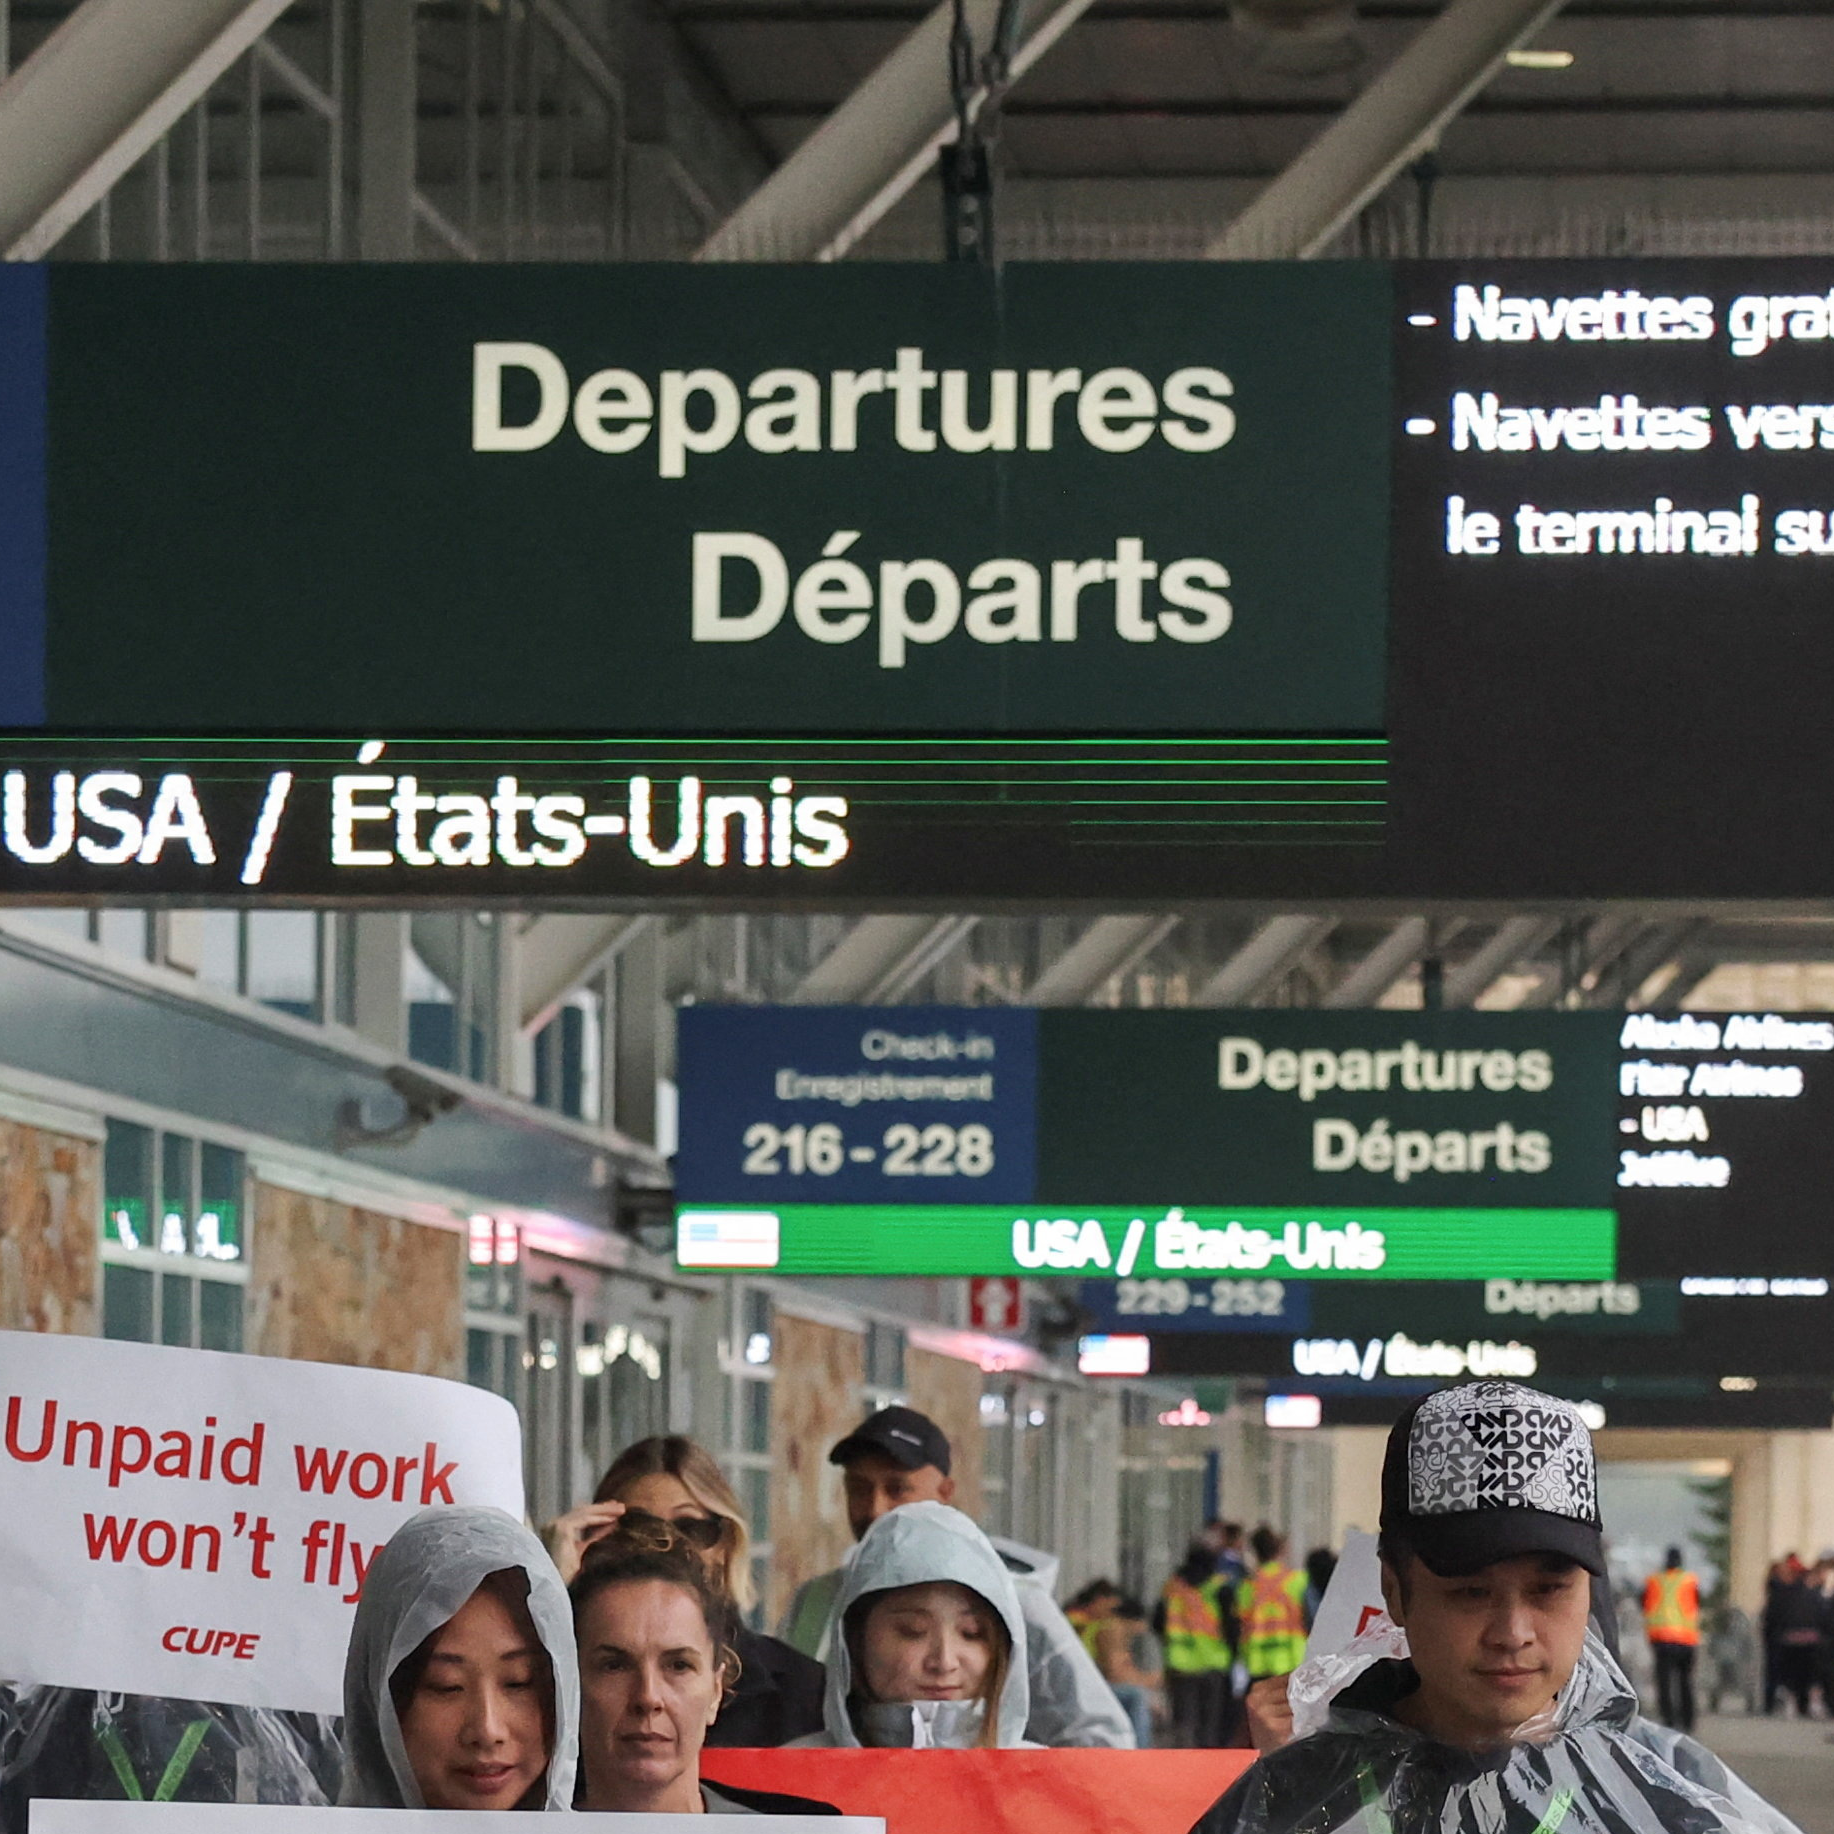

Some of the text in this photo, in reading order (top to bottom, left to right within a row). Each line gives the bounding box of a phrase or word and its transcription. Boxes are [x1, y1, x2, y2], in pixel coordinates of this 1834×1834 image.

[1454, 284, 1714, 341] Navettes
[473, 343, 1234, 478] Departures
[1453, 392, 1711, 451] Navettes
[1447, 495, 1501, 554] le
[1515, 494, 1759, 556] terminal
[693, 531, 1231, 668] Départs
[4, 771, 216, 865] USA
[332, 740, 848, 867] États-Unis
[860, 1029, 995, 1061] Check-in
[1218, 1037, 1553, 1102] Departures
[775, 1069, 994, 1107] Enregistrement
[1313, 1118, 1552, 1183] Départs
[1642, 1105, 1710, 1142] USA
[1013, 1219, 1109, 1269] USA
[1156, 1209, 1386, 1270] États-Unis
[5, 1396, 459, 1505] Unpaid work
[84, 1511, 384, 1604] won't fly
[162, 1626, 260, 1659] CUPE
